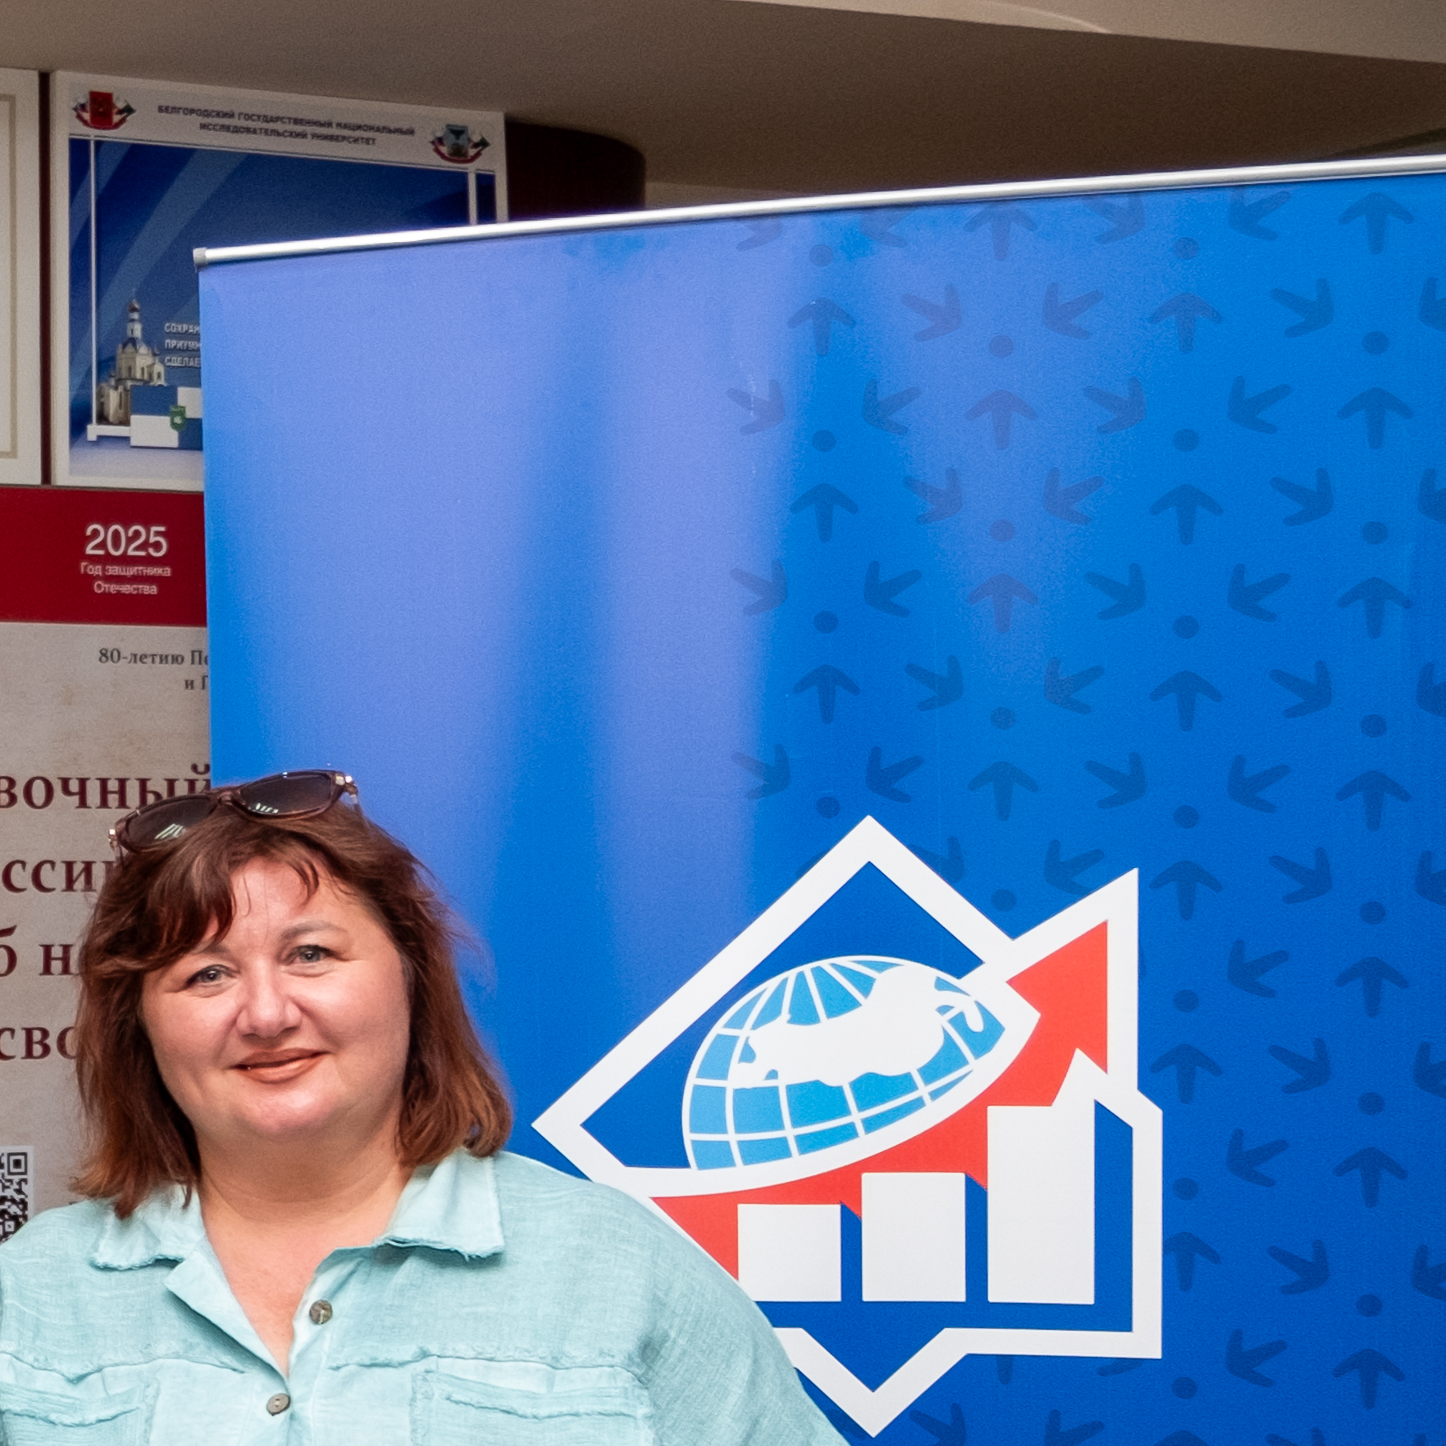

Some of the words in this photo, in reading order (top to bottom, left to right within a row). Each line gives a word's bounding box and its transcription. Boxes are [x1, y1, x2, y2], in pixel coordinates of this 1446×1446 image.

[85, 523, 168, 557] 2025
[80, 561, 102, 577] Год
[105, 564, 172, 578] защитника
[93, 580, 158, 595] Отечества
[98, 647, 185, 665] 80-летию
